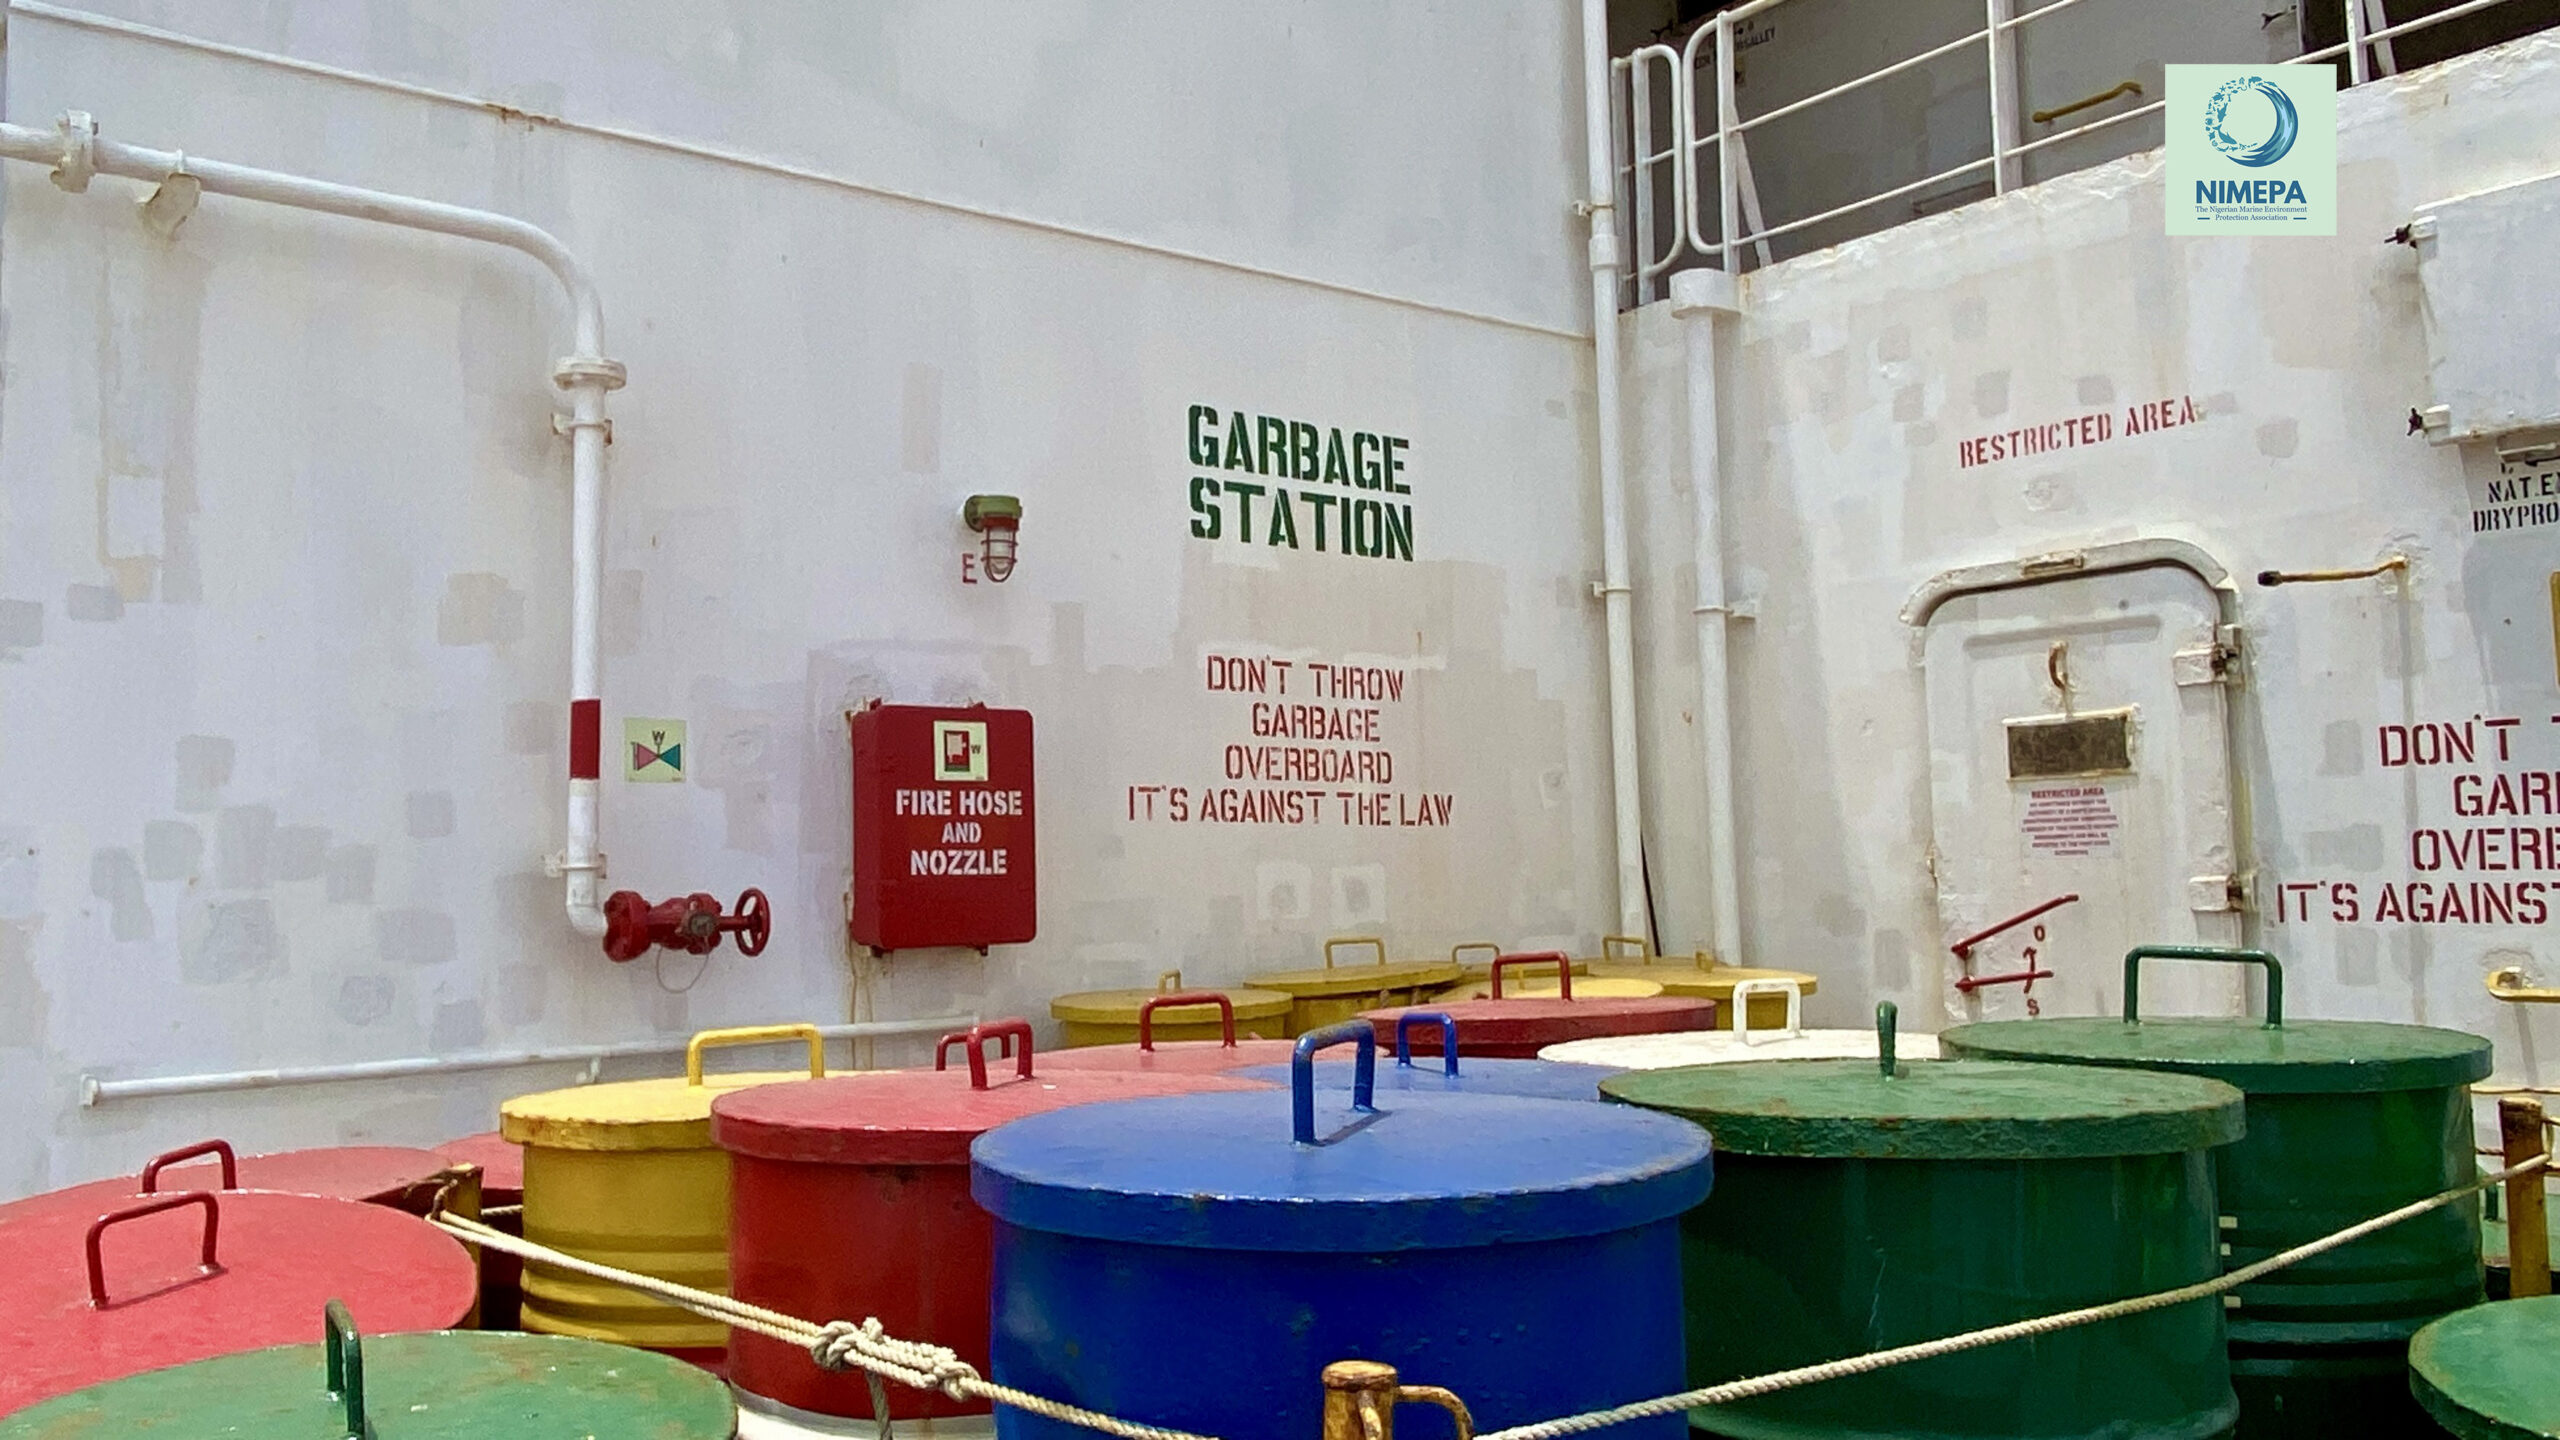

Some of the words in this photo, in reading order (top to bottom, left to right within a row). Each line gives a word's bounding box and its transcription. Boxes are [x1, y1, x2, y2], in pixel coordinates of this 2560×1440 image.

[1188, 404, 1411, 495] GARBAGE
[1959, 413, 2113, 469] RESTRICTED
[2125, 395, 2196, 437] AREA
[1189, 476, 1414, 562] STATION
[962, 553, 978, 584] E
[1206, 655, 1292, 694] DON'T
[1308, 663, 1404, 702] THROW
[1252, 702, 1381, 742] GARBAGE
[2378, 713, 2521, 767] DON'T
[970, 744, 981, 754] W
[1225, 745, 1393, 784] OVERBOARD
[896, 789, 952, 816] FIRE
[959, 789, 1023, 816] HOSE
[1128, 785, 1189, 822] IT'S
[1200, 788, 1326, 824] AGAINST
[1336, 792, 1391, 826] THE
[1400, 793, 1453, 827] LAW
[2031, 788, 2081, 799] RESTRICTED
[2082, 786, 2105, 797] AREA
[2453, 771, 2560, 816] GAR
[942, 822, 982, 844] AND
[910, 849, 1008, 876] NOZZLE
[2277, 880, 2360, 924] IT'S
[2375, 881, 2560, 925] AGAINS
[2027, 997, 2041, 1016] S
